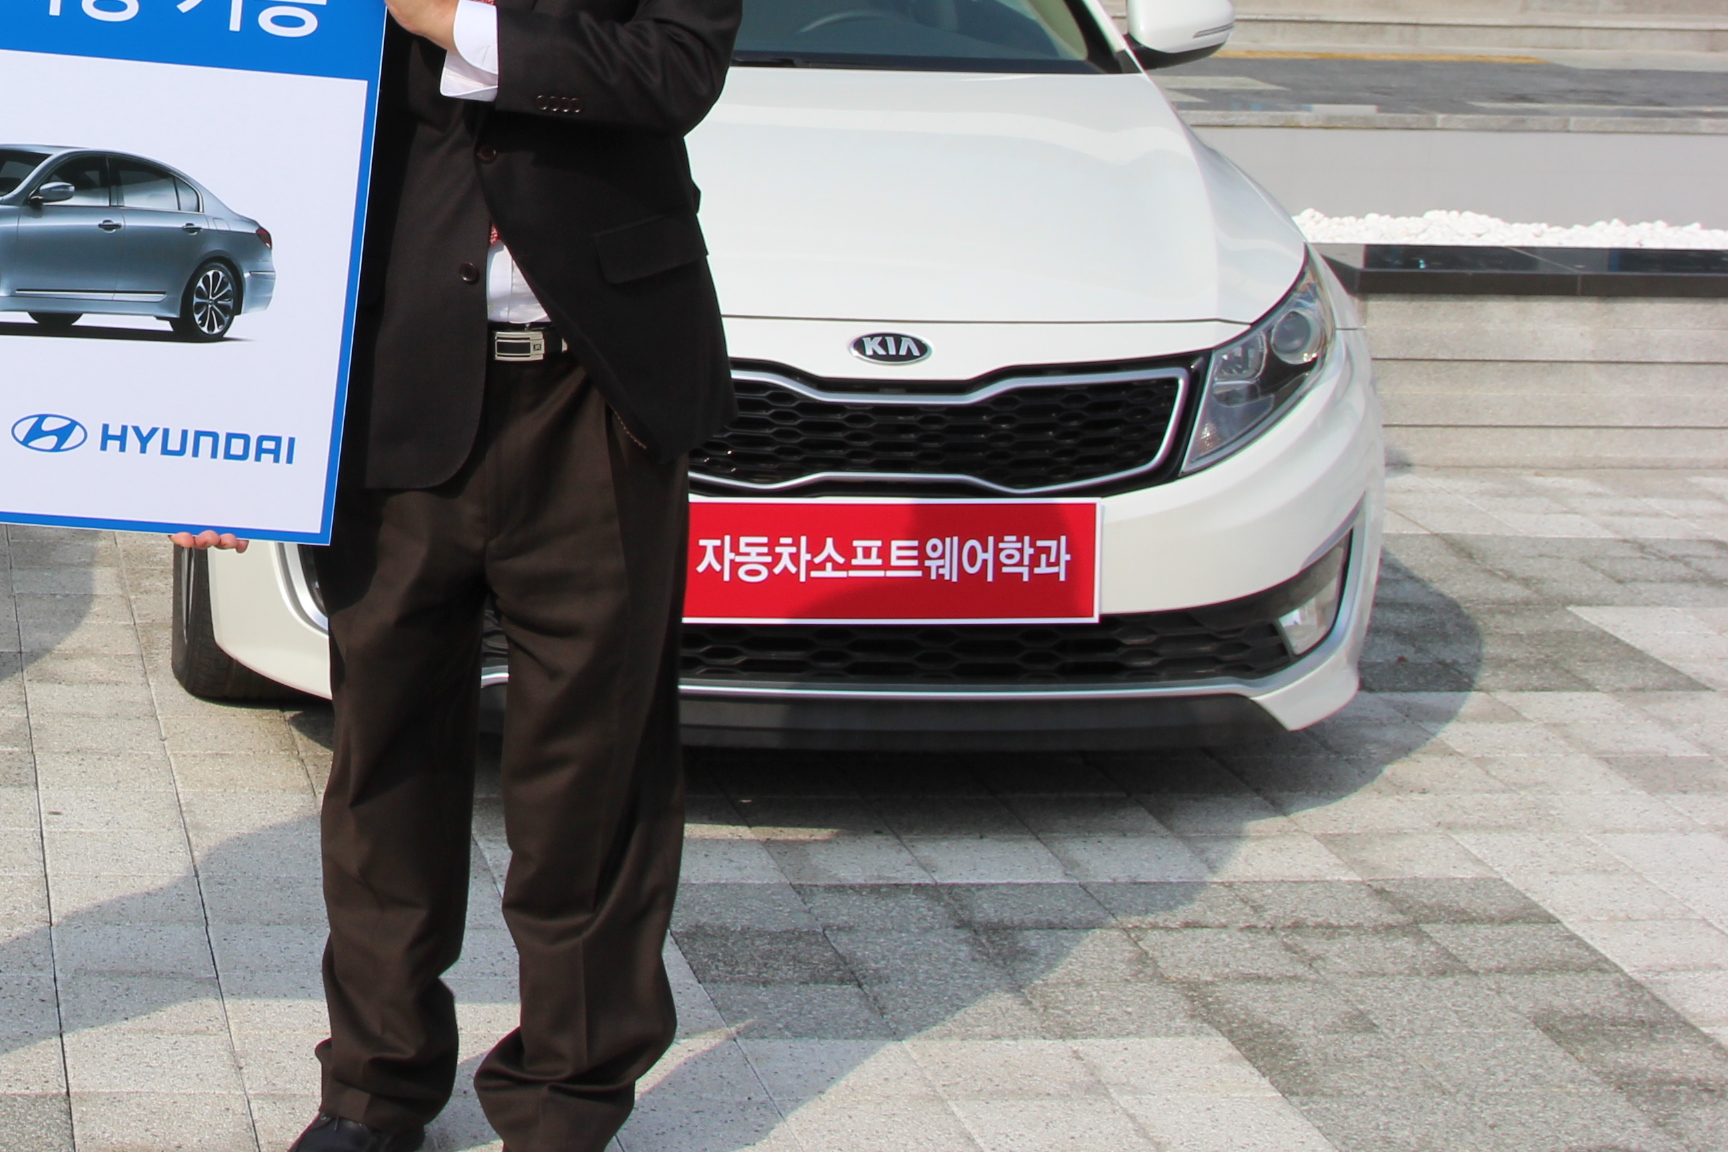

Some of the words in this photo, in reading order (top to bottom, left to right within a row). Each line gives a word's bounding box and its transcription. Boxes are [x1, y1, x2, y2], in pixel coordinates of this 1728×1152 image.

[862, 336, 921, 356] KIA
[100, 423, 296, 465] HYUNDAI
[696, 535, 1071, 583] 자동차소프트웨어학과
